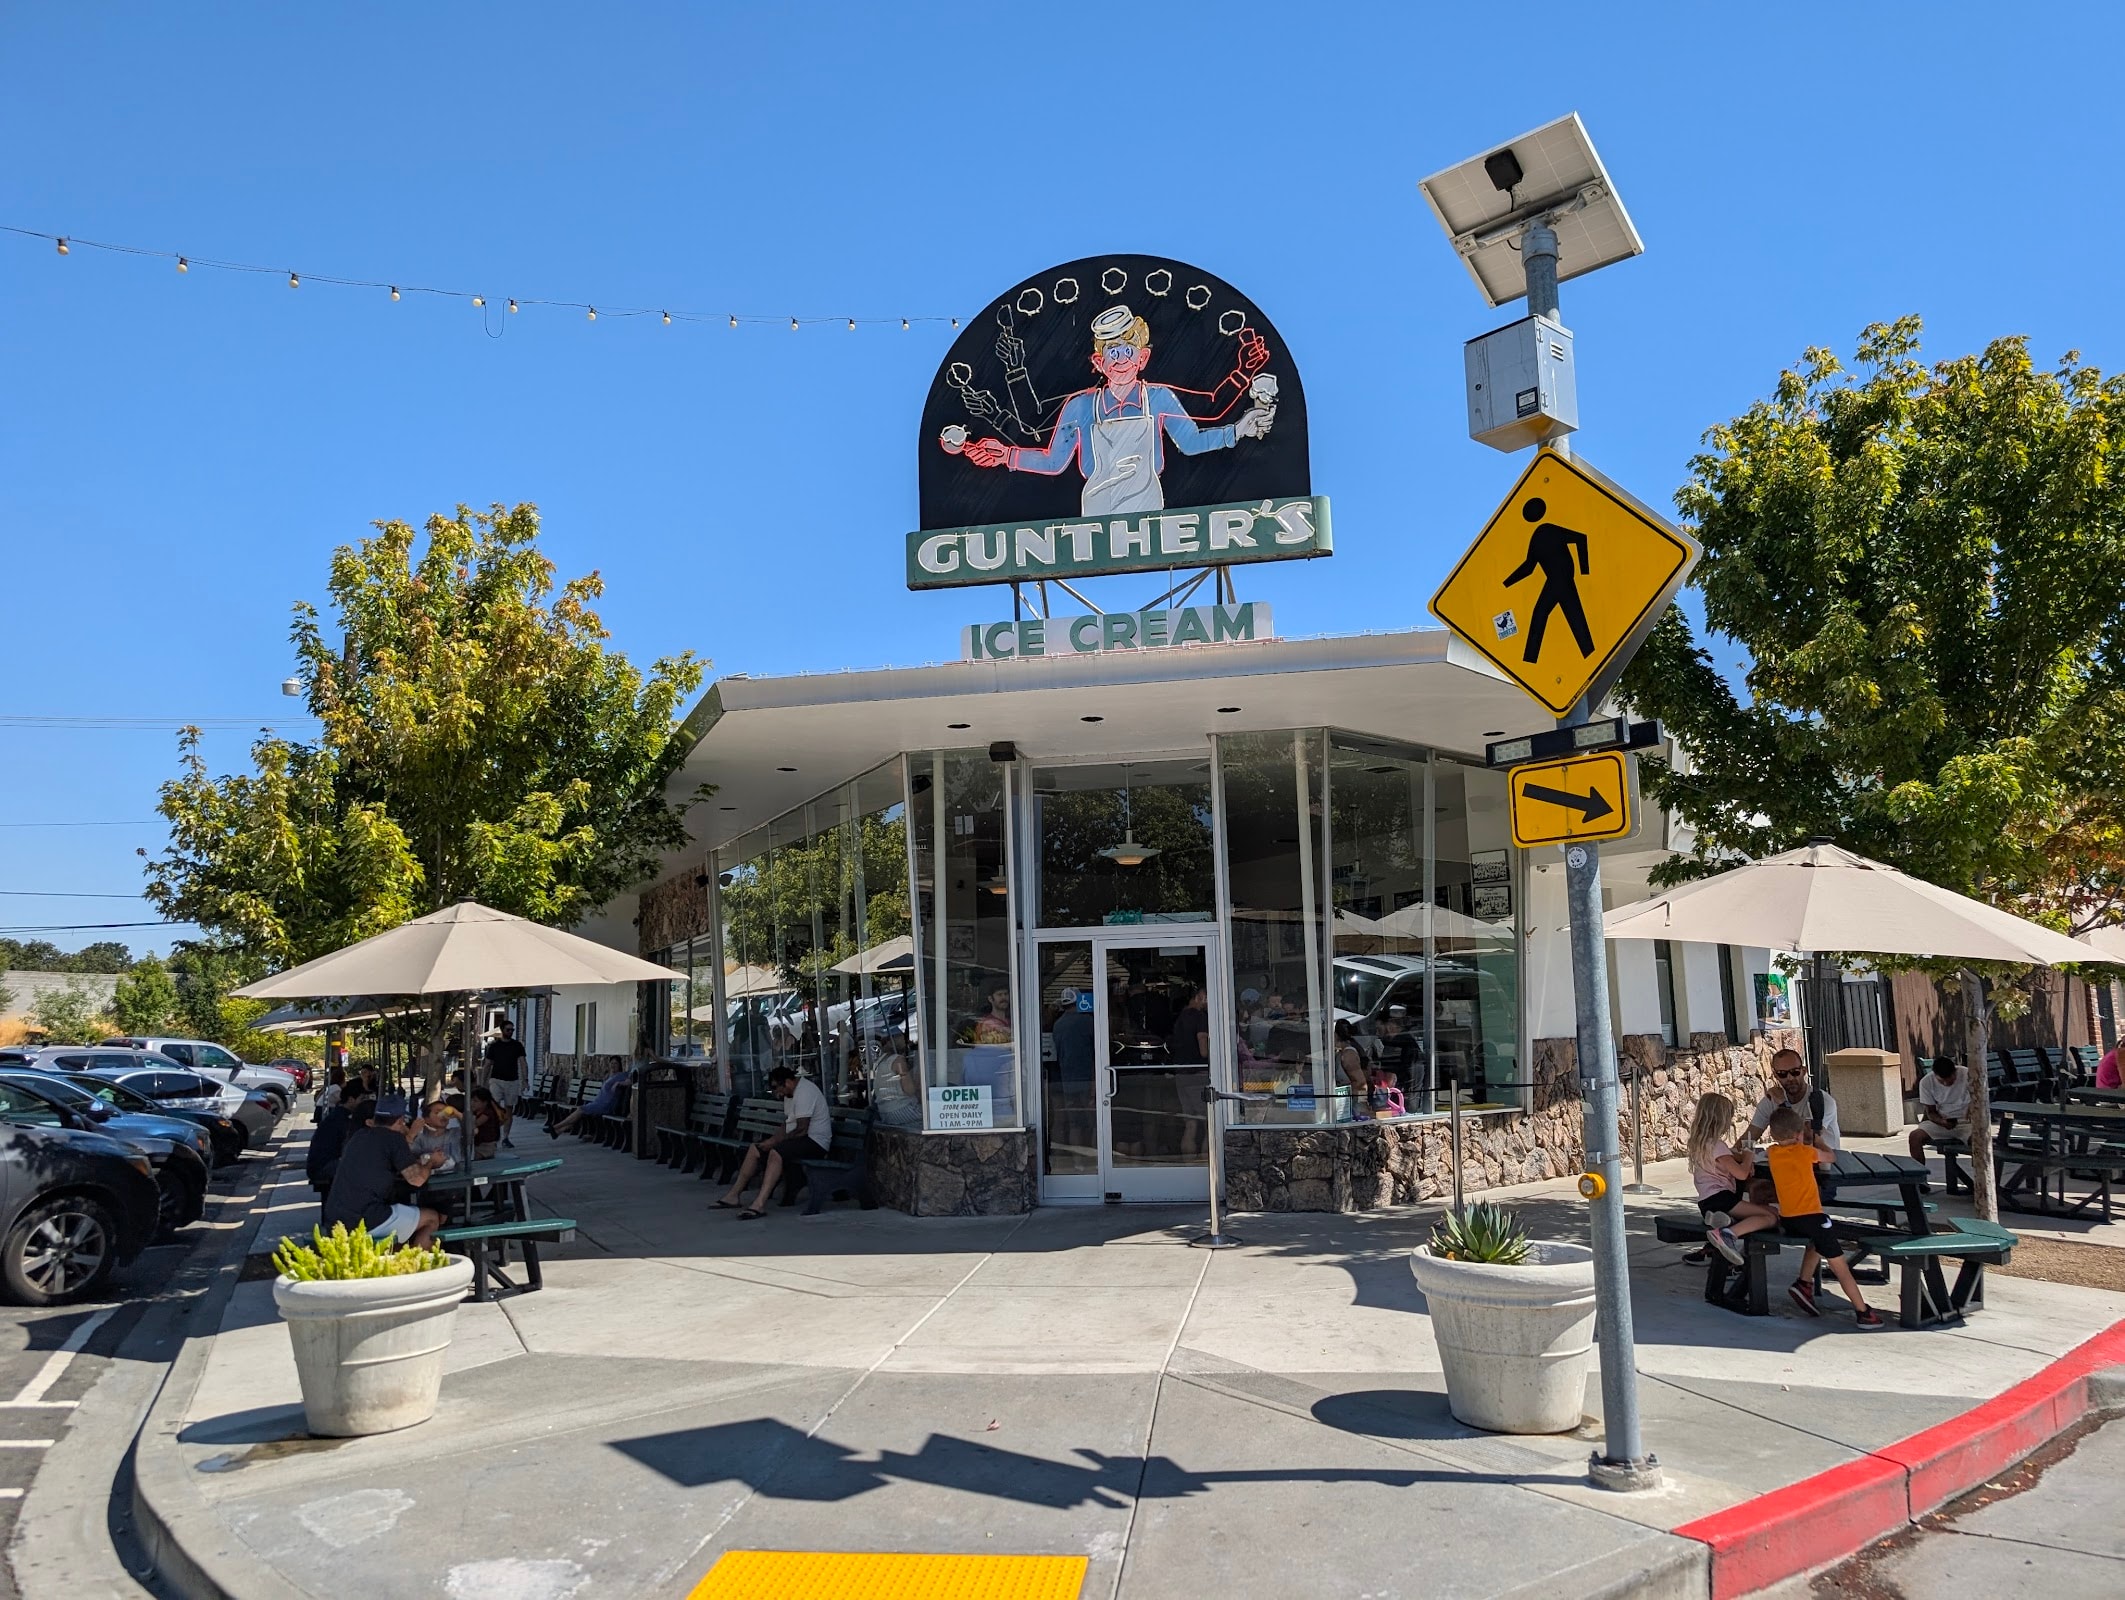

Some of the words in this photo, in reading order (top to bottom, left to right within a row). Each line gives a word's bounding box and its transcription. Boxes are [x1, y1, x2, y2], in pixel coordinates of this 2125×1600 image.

[917, 500, 1315, 573] GUNTHER'S
[971, 619, 1045, 660] ICE
[1068, 602, 1255, 653] CREAM
[942, 1088, 979, 1102] OPEN
[961, 1111, 983, 1119] DAILY
